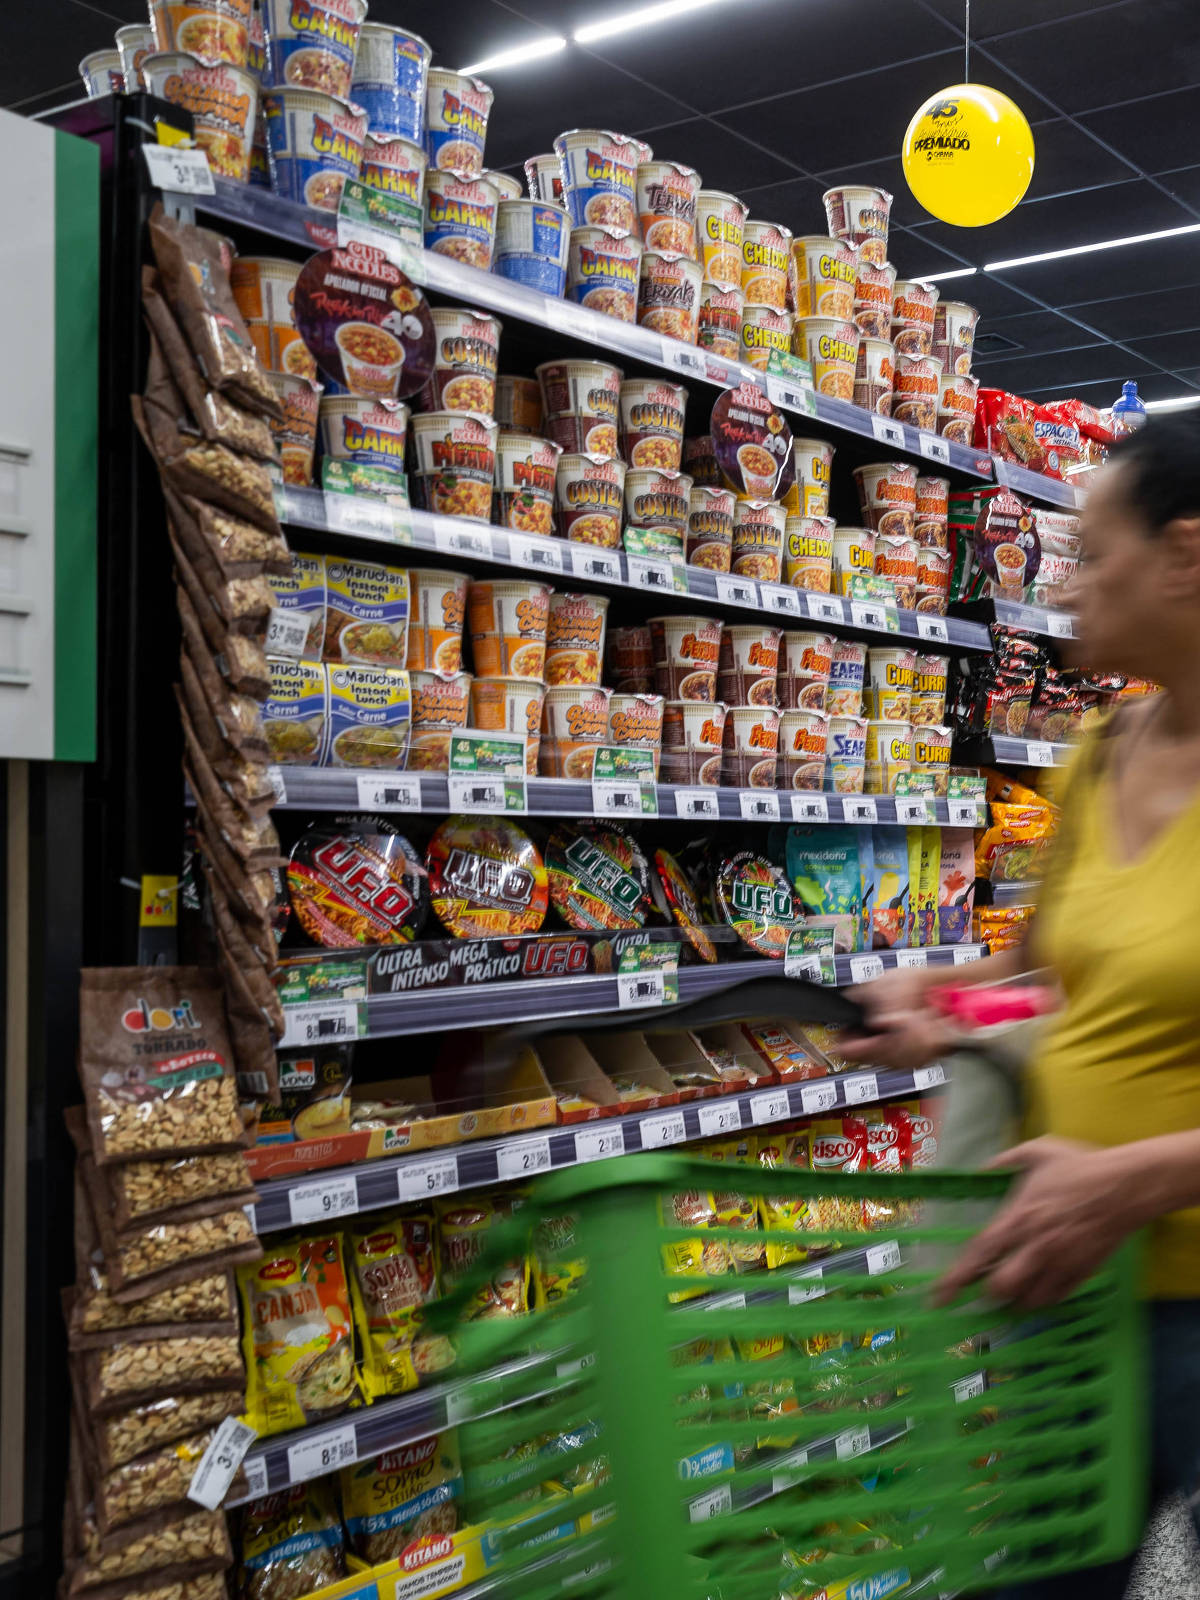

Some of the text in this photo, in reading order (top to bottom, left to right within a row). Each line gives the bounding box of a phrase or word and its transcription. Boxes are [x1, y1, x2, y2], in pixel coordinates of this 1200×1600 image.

[924, 99, 960, 120] 45
[914, 136, 971, 153] PREMIADO
[347, 240, 387, 261] CUP
[331, 248, 401, 285] NOODLES
[342, 564, 404, 586] Maruchan
[346, 579, 390, 594] Instant
[351, 590, 386, 603] Lunch
[352, 605, 384, 619] Carne
[345, 670, 404, 687] Maruchan
[350, 683, 391, 697] Instant
[355, 694, 388, 705] Lunch
[356, 710, 387, 723] Carne
[376, 948, 423, 976] ULTRA
[450, 943, 489, 967] MEGA
[391, 963, 449, 992] INTENSO
[464, 953, 520, 983] PRÁTICO
[121, 998, 202, 1033] dori
[281, 1074, 314, 1086] VONO
[384, 1137, 410, 1149] VONO
[379, 1441, 437, 1468] KITANO
[404, 1539, 451, 1569] KITANO
